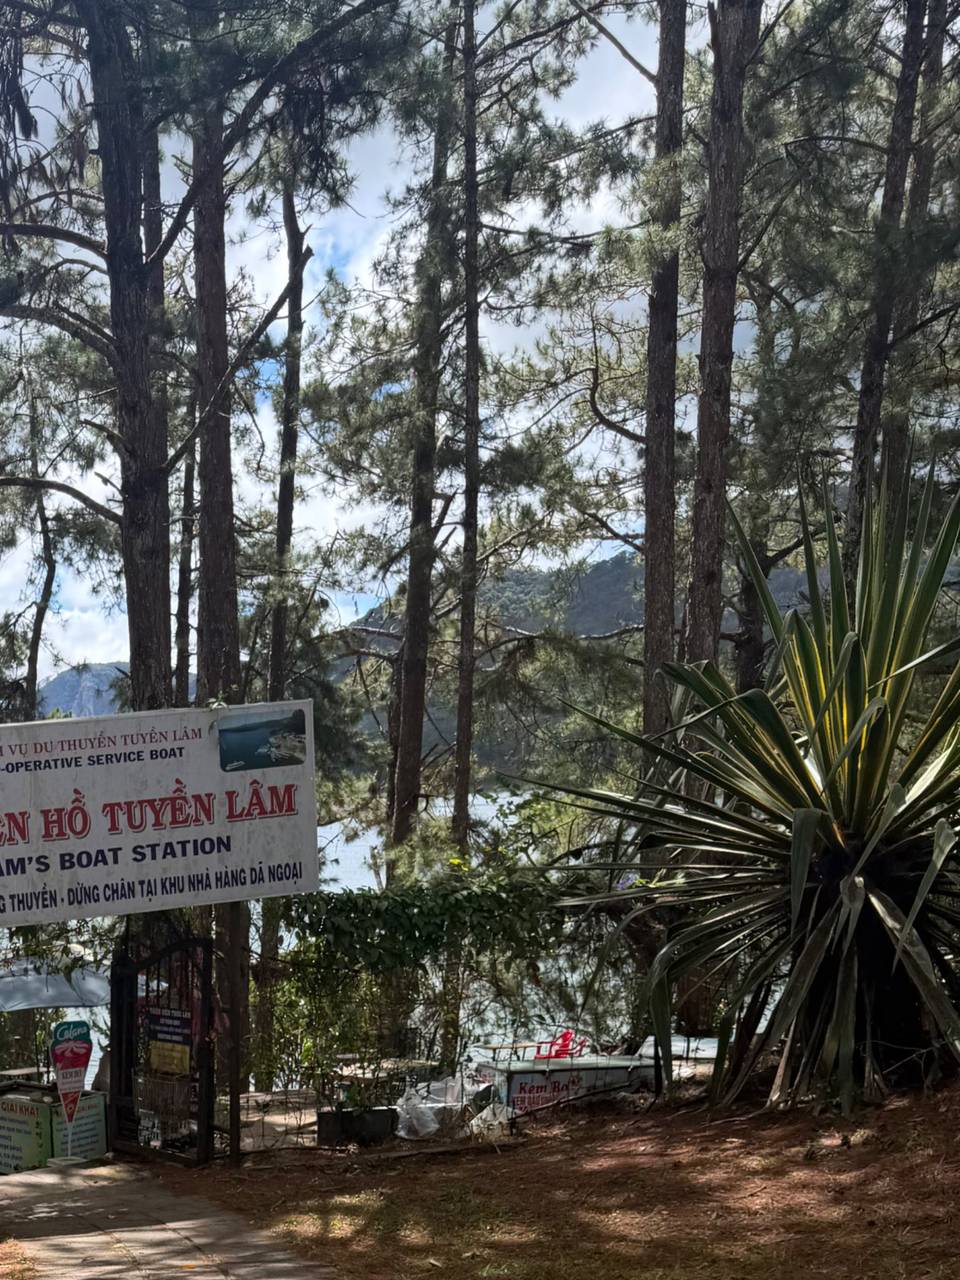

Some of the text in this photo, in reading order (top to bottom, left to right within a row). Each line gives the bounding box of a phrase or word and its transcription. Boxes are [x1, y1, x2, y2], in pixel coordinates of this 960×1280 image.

[8, 743, 28, 758] VỤ
[33, 740, 53, 753] DU
[173, 725, 202, 742] LÂM
[87, 750, 145, 766] SERVICE
[150, 747, 185, 761] BOAT
[40, 788, 90, 842] HỒ
[102, 778, 216, 835] TUYỀN
[225, 779, 299, 823] LÂM
[59, 847, 123, 871] BOAT
[132, 835, 232, 863] STATION
[68, 882, 100, 907] DỪNG
[103, 877, 136, 902] CHÂN
[139, 880, 158, 903] TẠI
[161, 876, 185, 895] KHU
[188, 868, 212, 892] NHÀ
[215, 865, 247, 890] HÀNG
[268, 861, 303, 885] NGOẠI
